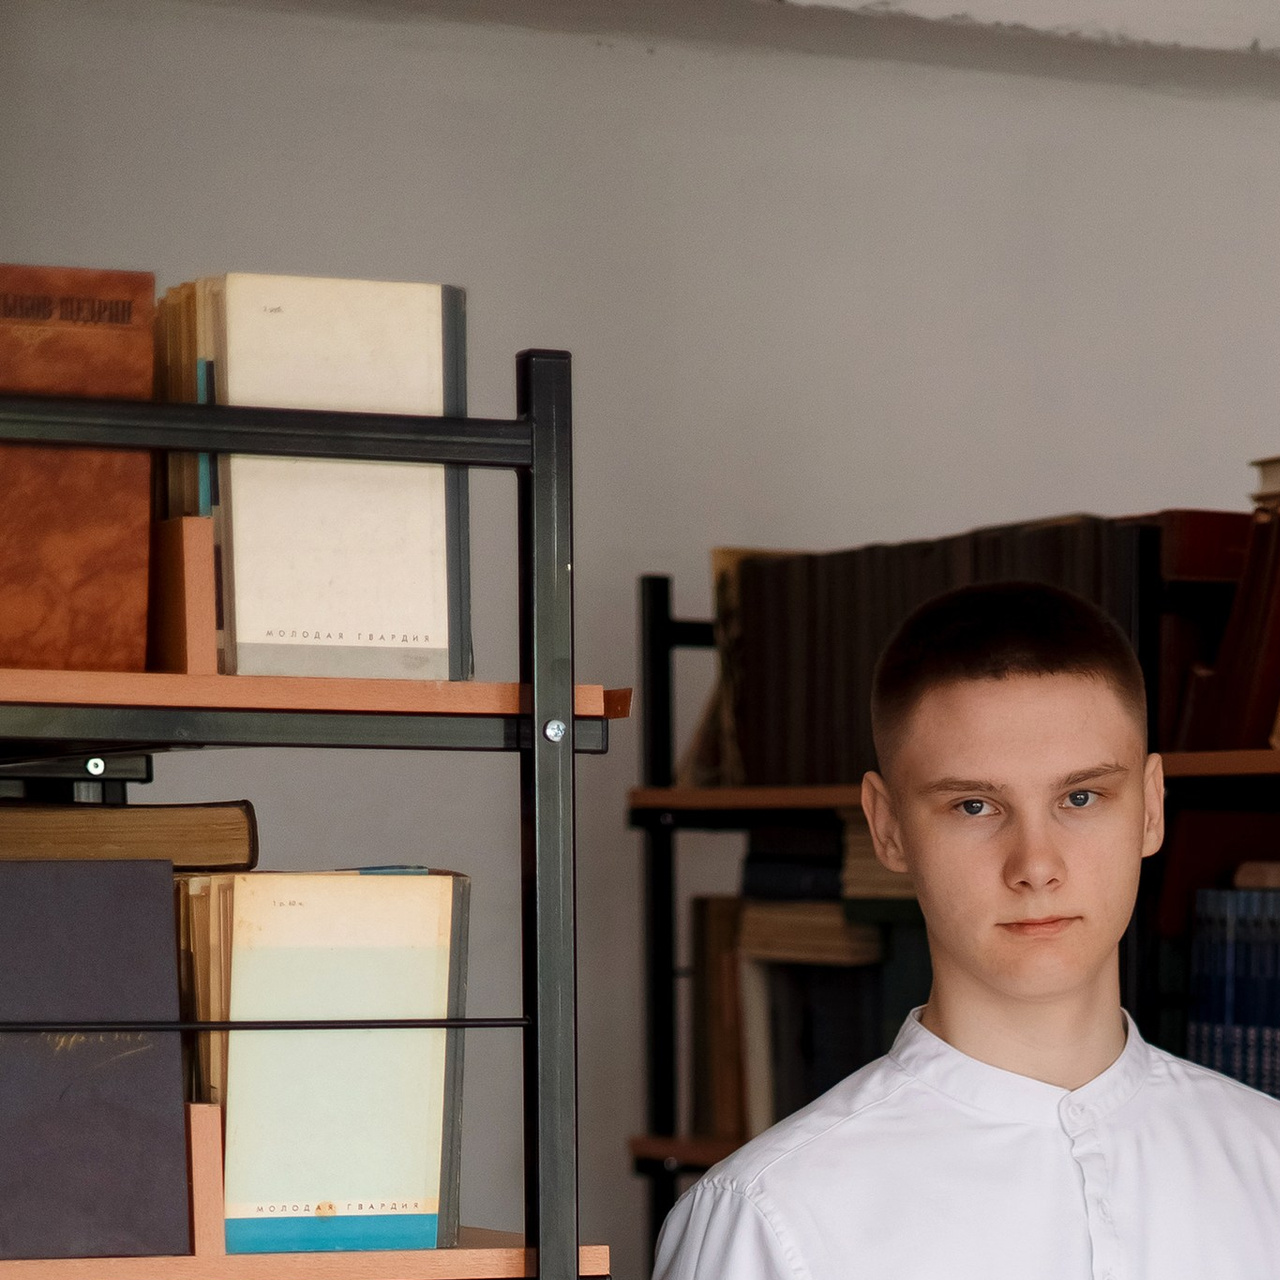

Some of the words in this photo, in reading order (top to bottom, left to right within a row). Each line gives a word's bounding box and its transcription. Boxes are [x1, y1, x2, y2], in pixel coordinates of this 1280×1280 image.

[265, 629, 344, 640] МОЛОДАЯ
[357, 632, 430, 643] ГВАРДИЯ
[256, 1203, 334, 1213] МОЛОДАЯ
[346, 1202, 419, 1211] ГВАРДИЯ
